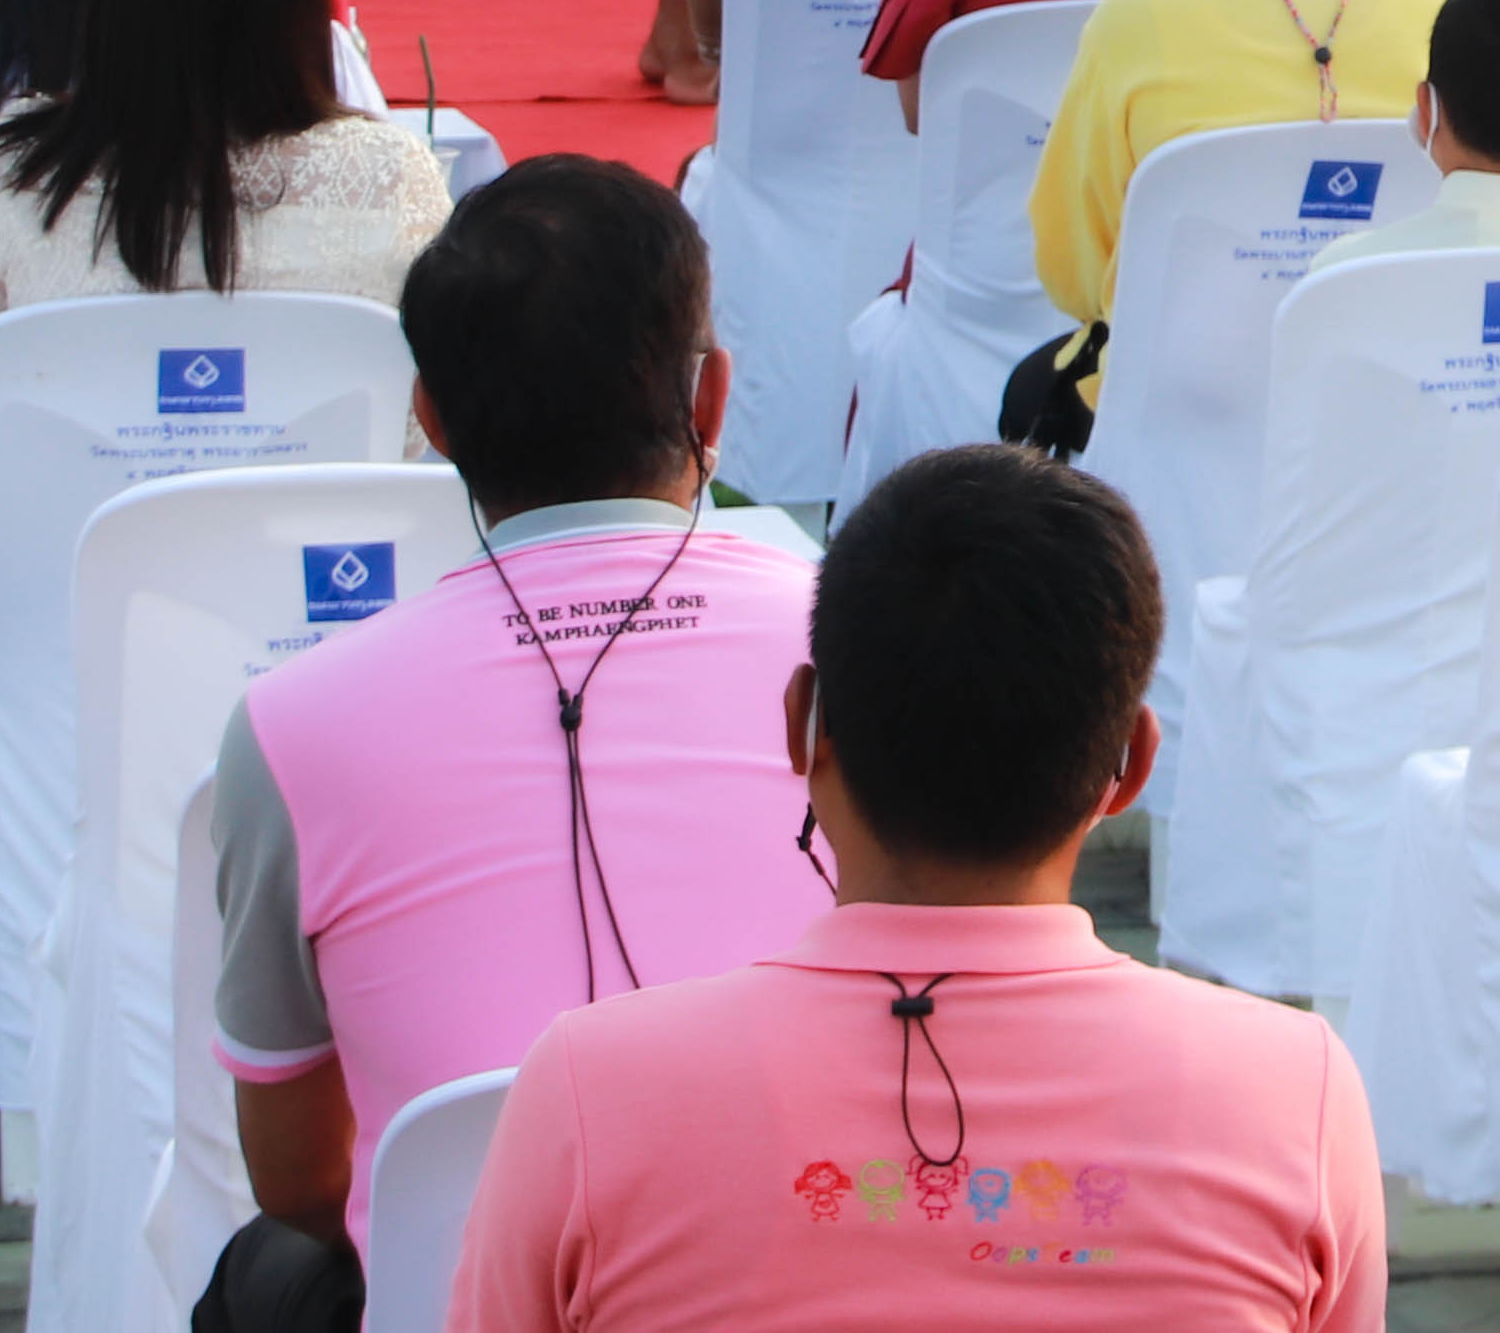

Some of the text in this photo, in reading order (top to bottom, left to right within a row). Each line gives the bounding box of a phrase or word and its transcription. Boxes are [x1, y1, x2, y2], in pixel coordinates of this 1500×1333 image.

[503, 594, 708, 628] TO BE NUMBER ONE
[516, 615, 701, 646] KAMPHAENGPHET
